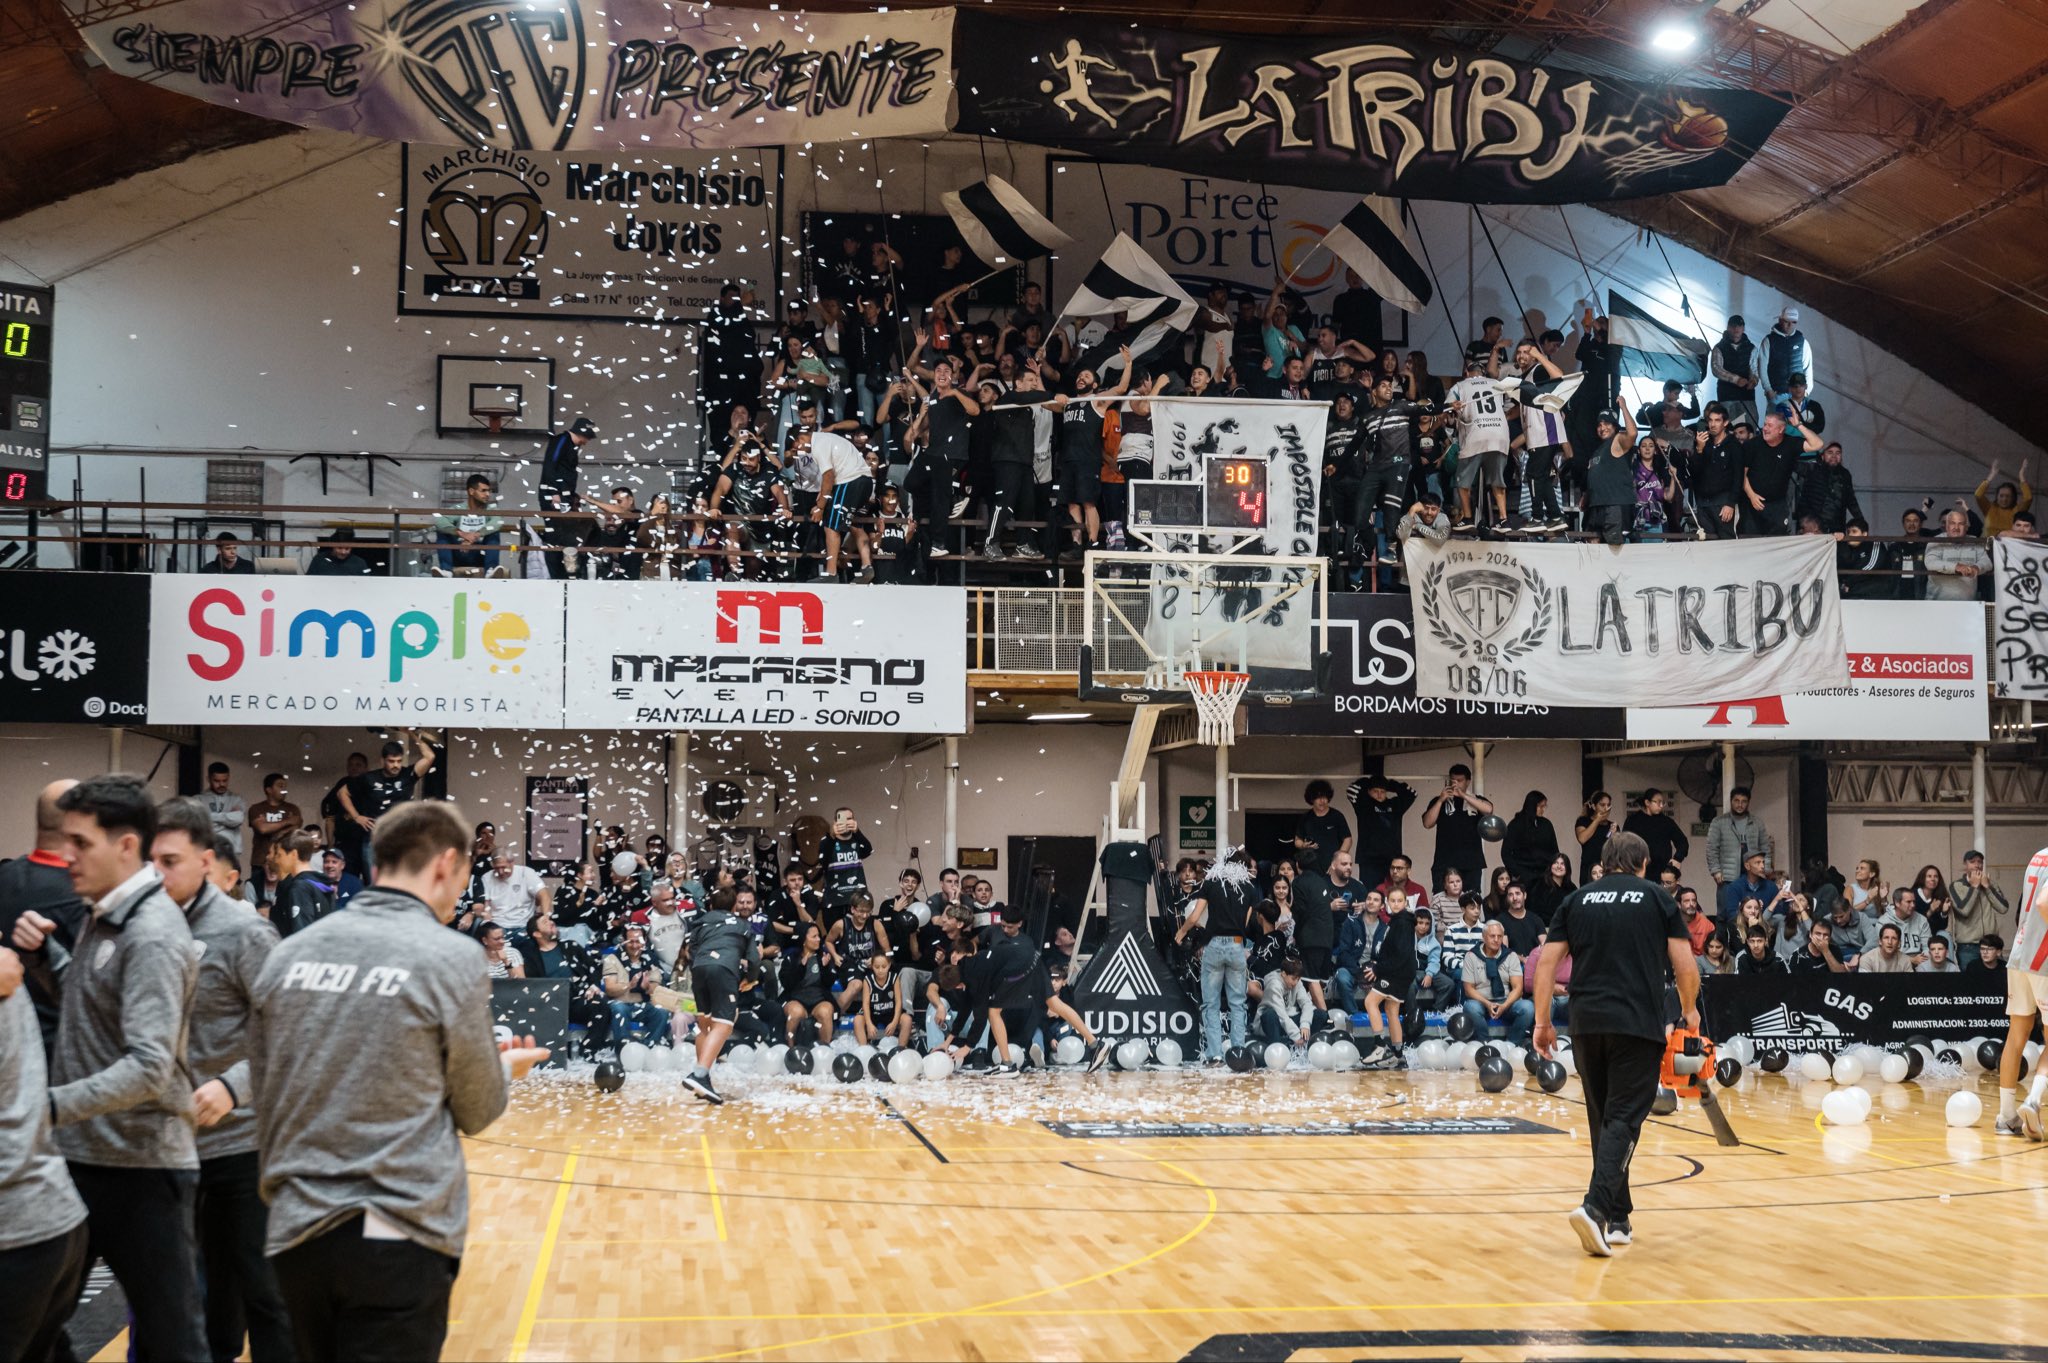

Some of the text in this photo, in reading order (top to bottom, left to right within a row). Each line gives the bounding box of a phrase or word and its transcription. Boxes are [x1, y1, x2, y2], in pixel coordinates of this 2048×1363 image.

[113, 22, 364, 98] SIEMPRE
[610, 38, 944, 119] PRESENTE
[422, 149, 550, 188] MARCHISIO
[566, 162, 764, 207] Marchisio
[1181, 178, 1279, 221] Free
[613, 214, 722, 257] Joyas
[1125, 202, 1272, 267] Port
[566, 271, 577, 280] La
[637, 273, 685, 282] Tradicional
[688, 275, 698, 283] de
[443, 279, 524, 297] JOYAS
[0, 292, 41, 315] ITA
[594, 295, 606, 304] 17
[4, 322, 31, 357] 0
[1472, 391, 1497, 414] 13
[19, 419, 39, 428] uno
[1171, 420, 1187, 462] 1919
[1225, 465, 1250, 484] 30
[1273, 422, 1317, 536] IMPOSIBLE
[5, 473, 27, 500] 0
[1238, 491, 1263, 523] 4
[1447, 552, 1474, 564] 1994
[1486, 552, 1518, 568] 2024
[187, 588, 531, 683] Simple
[1472, 639, 1498, 656] 30
[1861, 656, 1876, 673] &
[1881, 657, 1969, 674] Asociados
[1447, 663, 1528, 698] 08/06
[207, 694, 509, 713] MERCADO MAYORISTA
[612, 688, 925, 704] EVENTOS
[1868, 686, 1916, 697] Asesores
[1919, 687, 1931, 697] de
[1934, 687, 1975, 701] Seguros
[1335, 695, 1447, 714] BORDAMOS
[1454, 699, 1487, 715] TUS
[635, 707, 746, 724] PANTALLA
[753, 709, 795, 725] LED
[814, 710, 901, 726] SONIDO
[836, 851, 858, 862] PICO
[1582, 891, 1644, 905] PICO FC
[282, 961, 411, 997] PICO FC
[1824, 988, 1874, 1021] GAS
[1907, 996, 2004, 1005] LOGISTICA: 2302-670237
[1076, 1011, 1193, 1035] UDISIO
[1892, 1019, 2010, 1029] ADMINISTRACION: 2302-6085
[1749, 1038, 1843, 1050] TRANSPORTE
